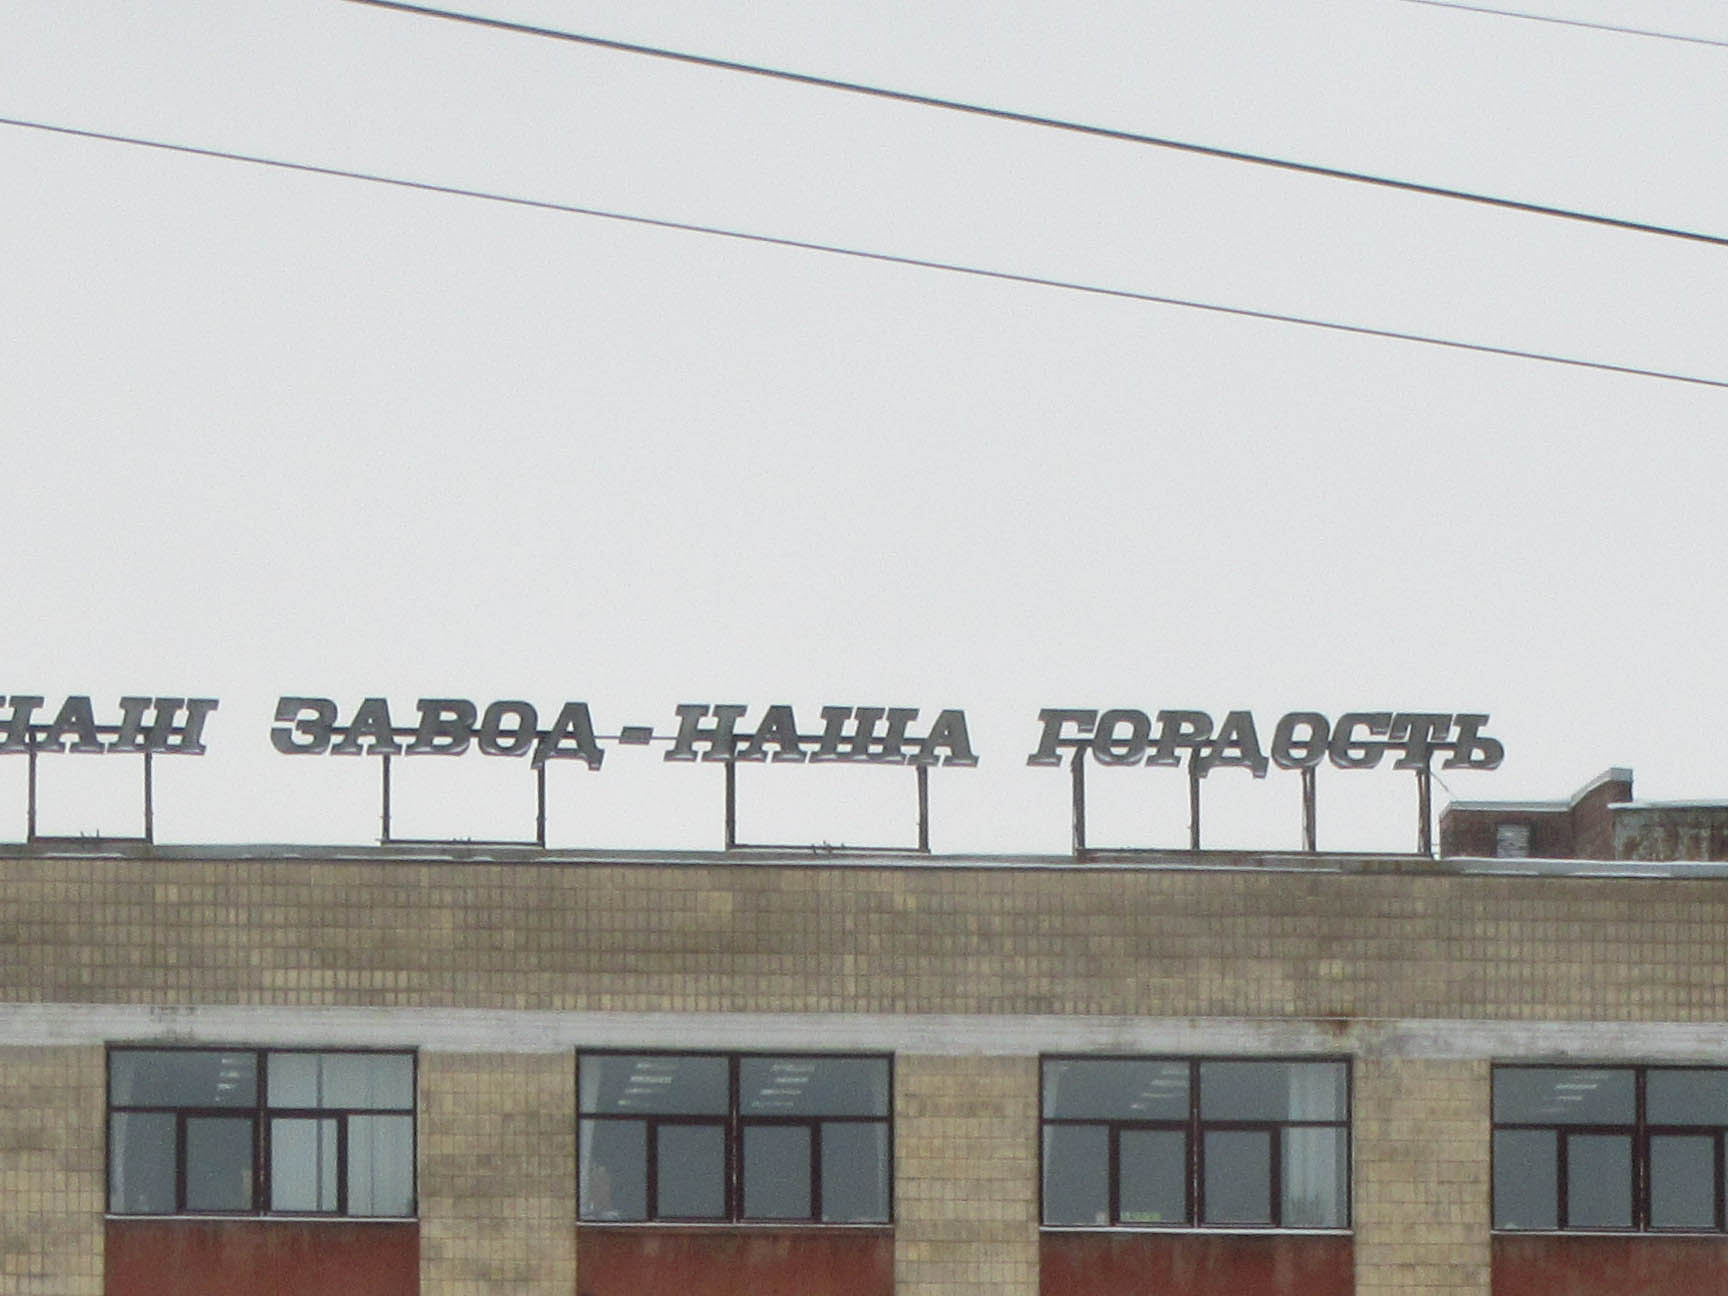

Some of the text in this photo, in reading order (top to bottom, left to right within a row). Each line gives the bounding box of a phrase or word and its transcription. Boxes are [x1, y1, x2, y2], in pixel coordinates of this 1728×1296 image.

[269, 697, 605, 771] ЗАВОД
[663, 704, 979, 768] НАША
[1026, 708, 1505, 778] ГОРДОСТЬ
